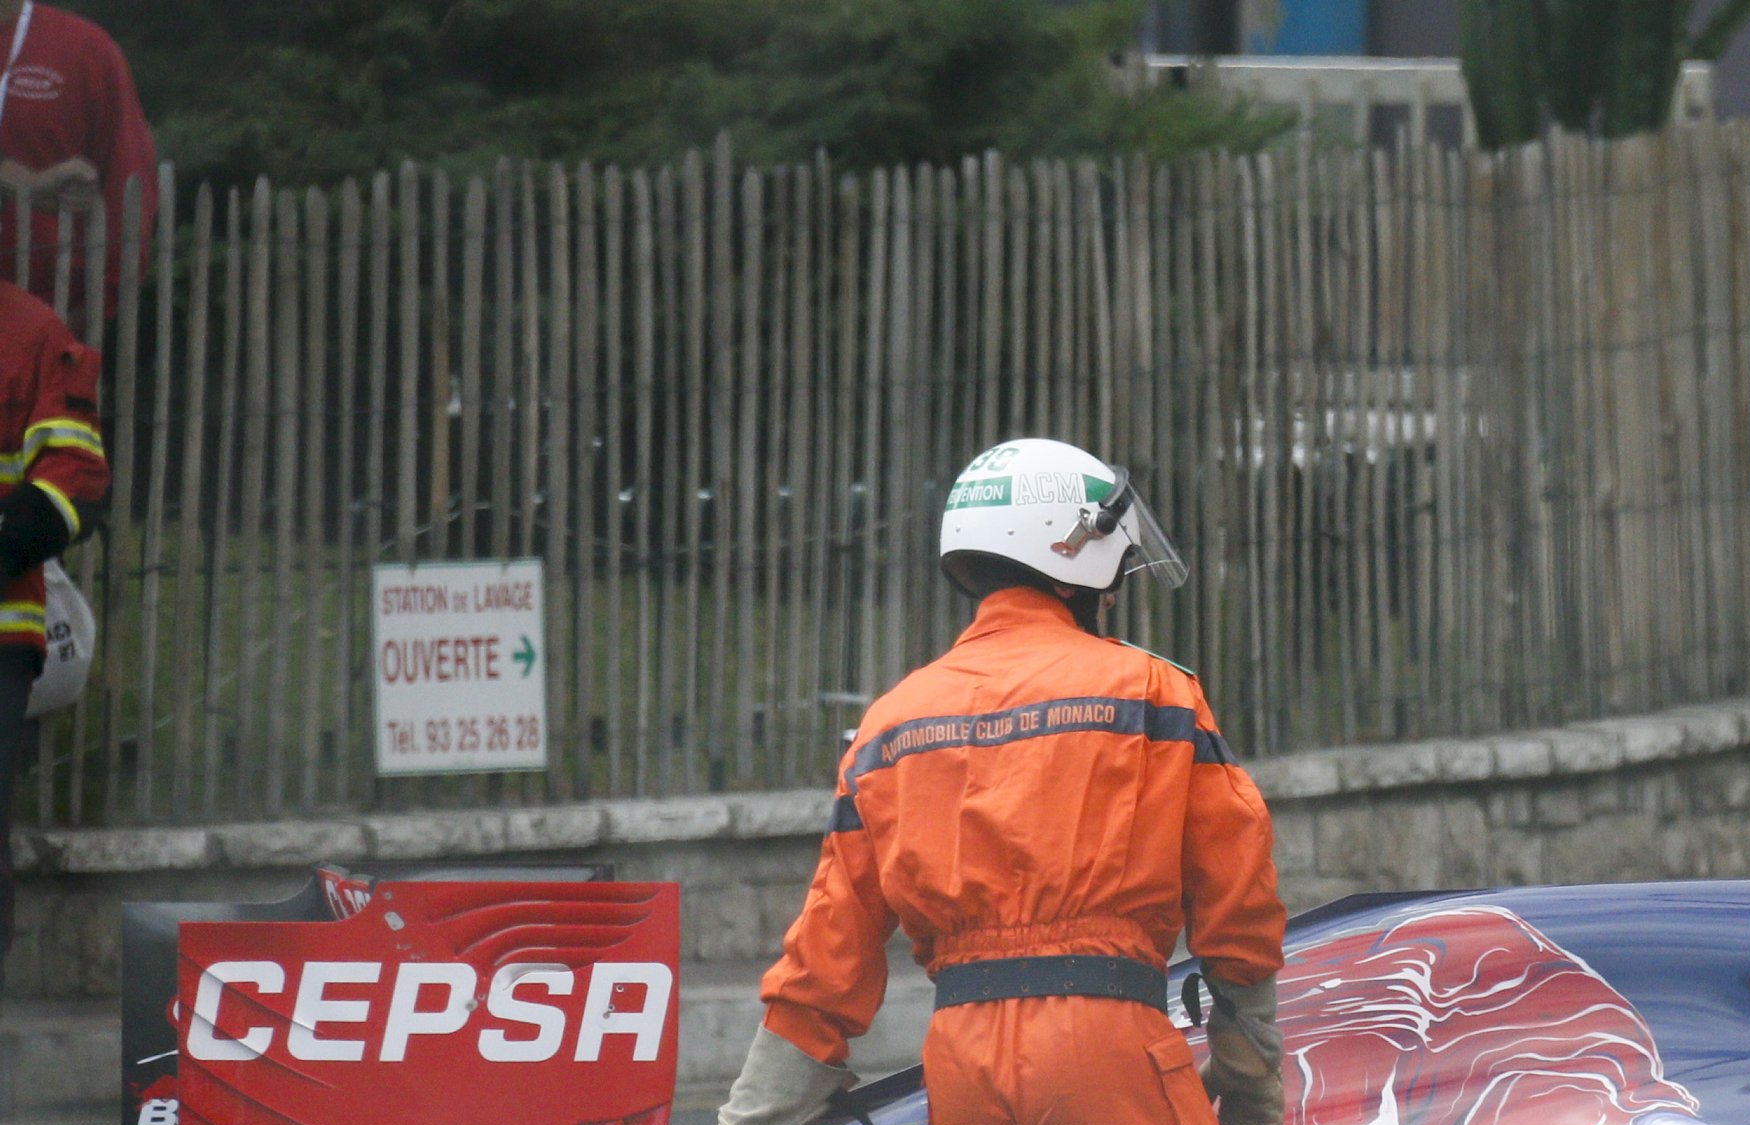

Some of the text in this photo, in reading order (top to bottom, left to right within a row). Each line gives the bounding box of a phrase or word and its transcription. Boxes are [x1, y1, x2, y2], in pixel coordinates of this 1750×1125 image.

[1014, 471, 1083, 506] ACM
[382, 585, 448, 616] STATION
[474, 580, 534, 613] LAVAGE
[382, 634, 501, 685] OUVERTE
[426, 717, 451, 752] 93
[457, 715, 480, 752] 25
[487, 714, 510, 751] 26
[515, 713, 541, 751] 28
[881, 704, 1116, 763] AUTOMOBILE CLUB DE MONACO
[186, 960, 675, 1063] CEPSA
